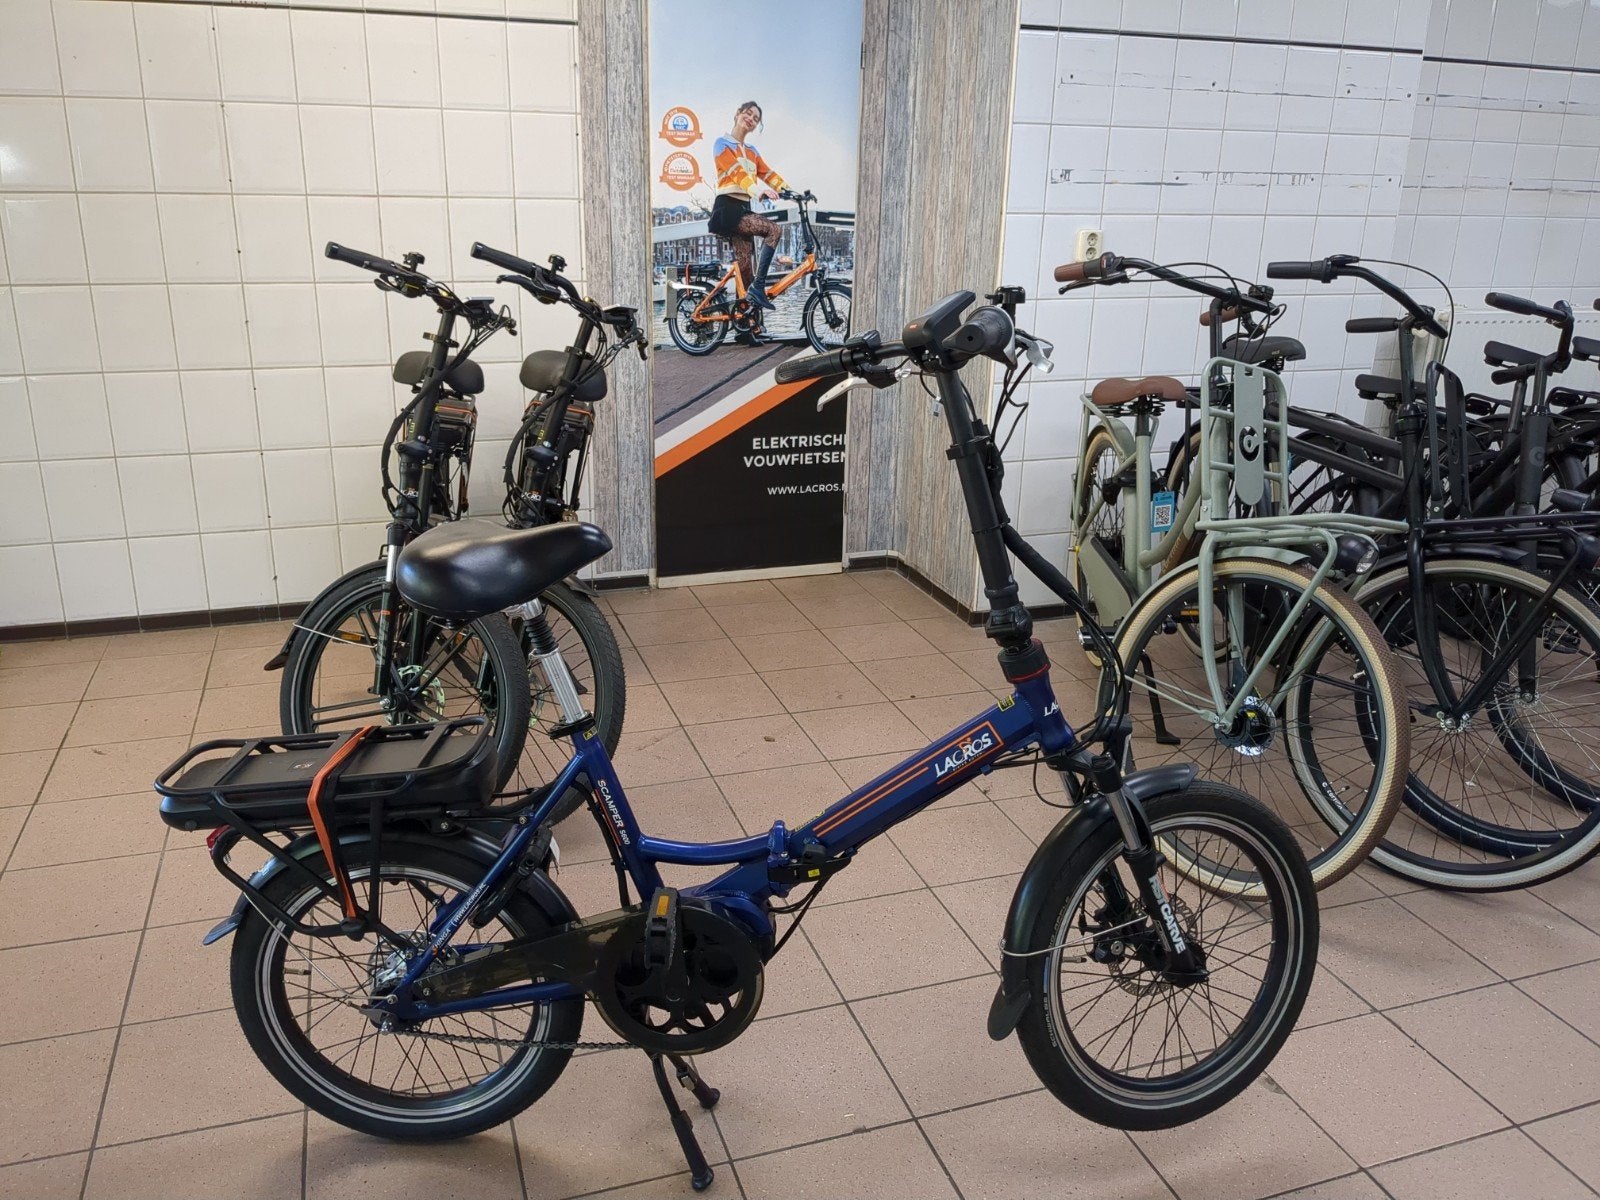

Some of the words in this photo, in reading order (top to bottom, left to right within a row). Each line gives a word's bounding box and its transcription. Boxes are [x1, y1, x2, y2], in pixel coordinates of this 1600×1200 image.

[752, 434, 846, 450] ELEKTRISCH
[934, 732, 993, 777] LACROS
[597, 779, 625, 829] SCAMPER
[1160, 903, 1186, 954] CARVE
